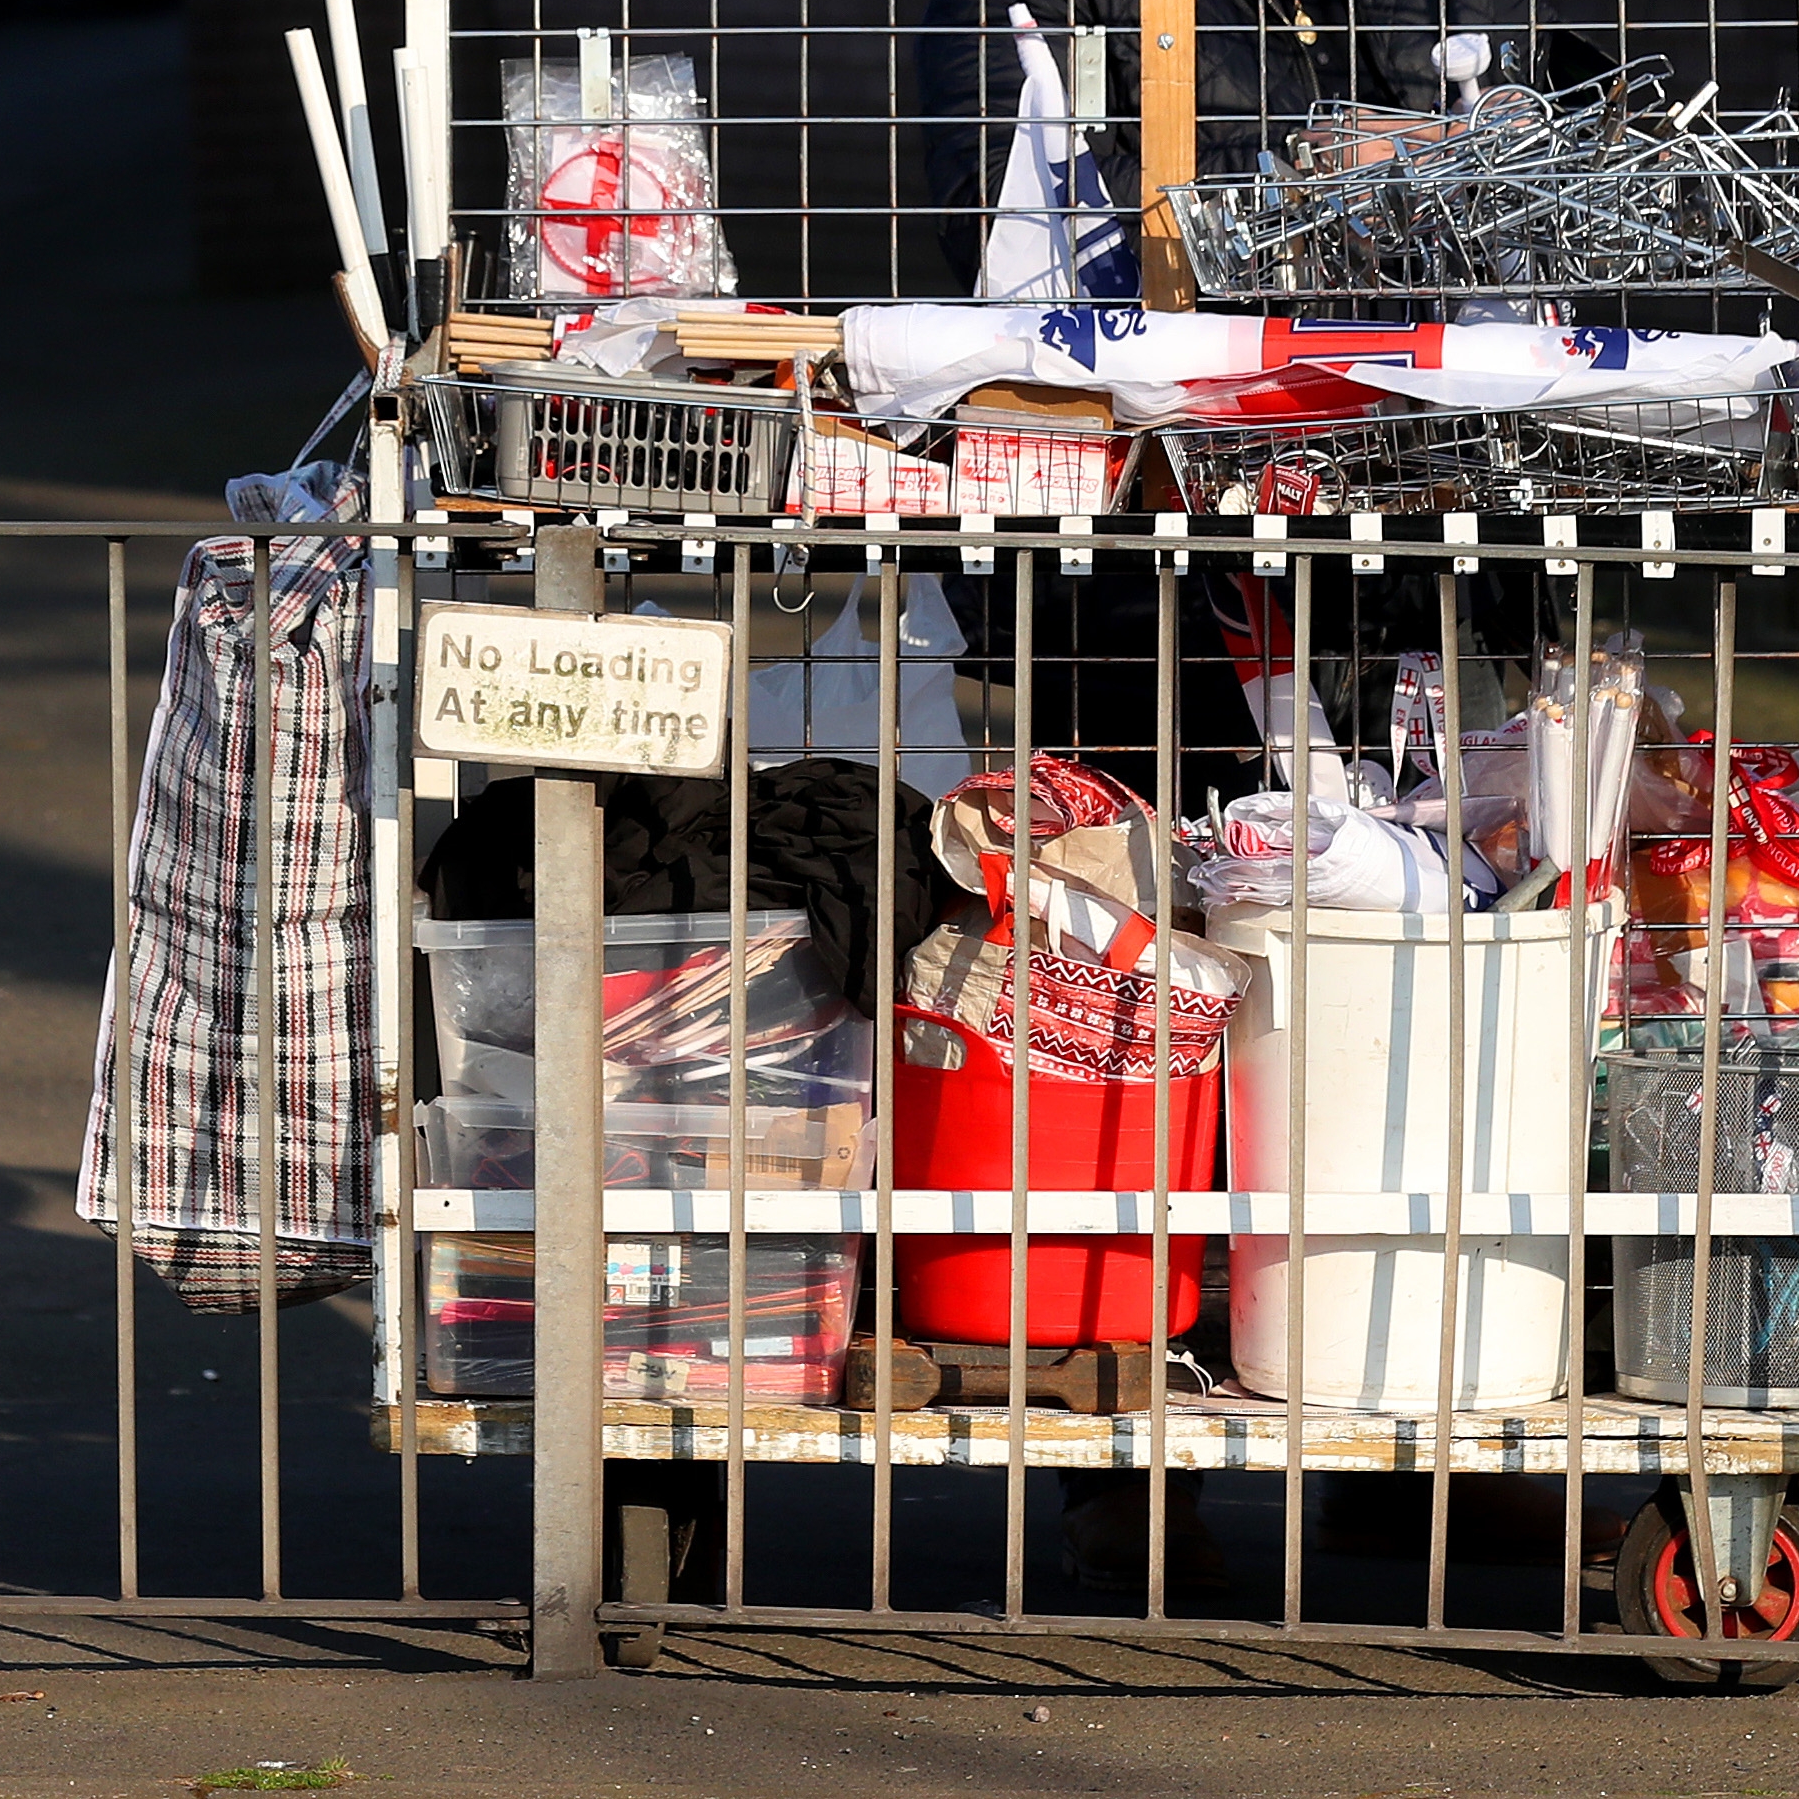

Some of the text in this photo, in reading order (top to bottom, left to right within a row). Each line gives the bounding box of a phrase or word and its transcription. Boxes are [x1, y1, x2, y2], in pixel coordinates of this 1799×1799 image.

[1277, 482, 1303, 501] MALT
[439, 633, 703, 693] No Loading
[435, 687, 709, 741] At any time
